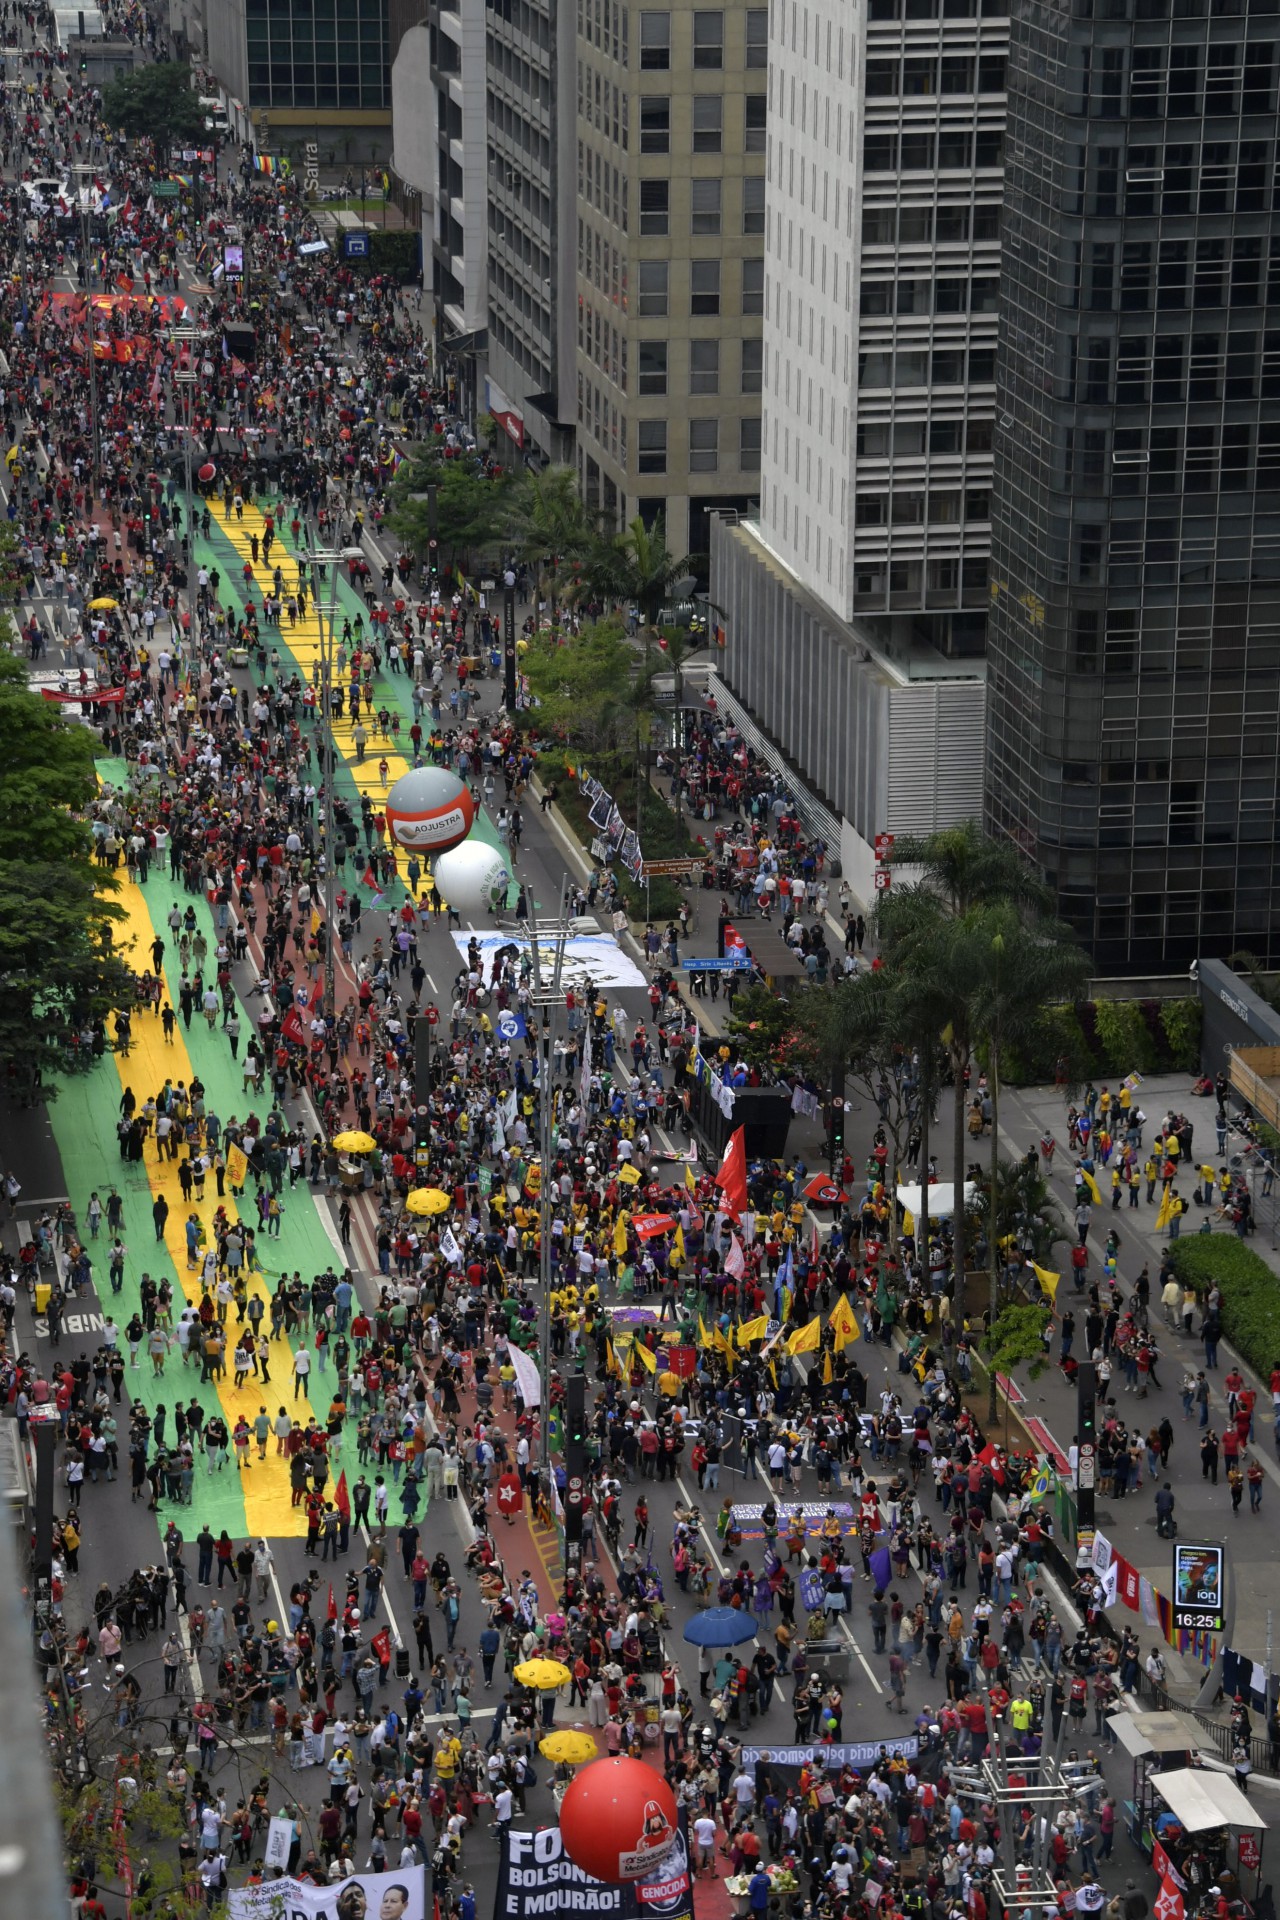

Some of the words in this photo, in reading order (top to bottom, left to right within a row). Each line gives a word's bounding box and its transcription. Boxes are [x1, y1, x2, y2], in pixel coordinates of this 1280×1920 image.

[304, 142, 319, 191] Safra
[414, 814, 461, 833] AOJUSTRA
[1176, 1613, 1214, 1628] 16:25
[508, 1827, 570, 1864] FO
[641, 1878, 687, 1899] GENOCIDA
[506, 1893, 519, 1914] E
[524, 1888, 621, 1915] MOURÃO!
